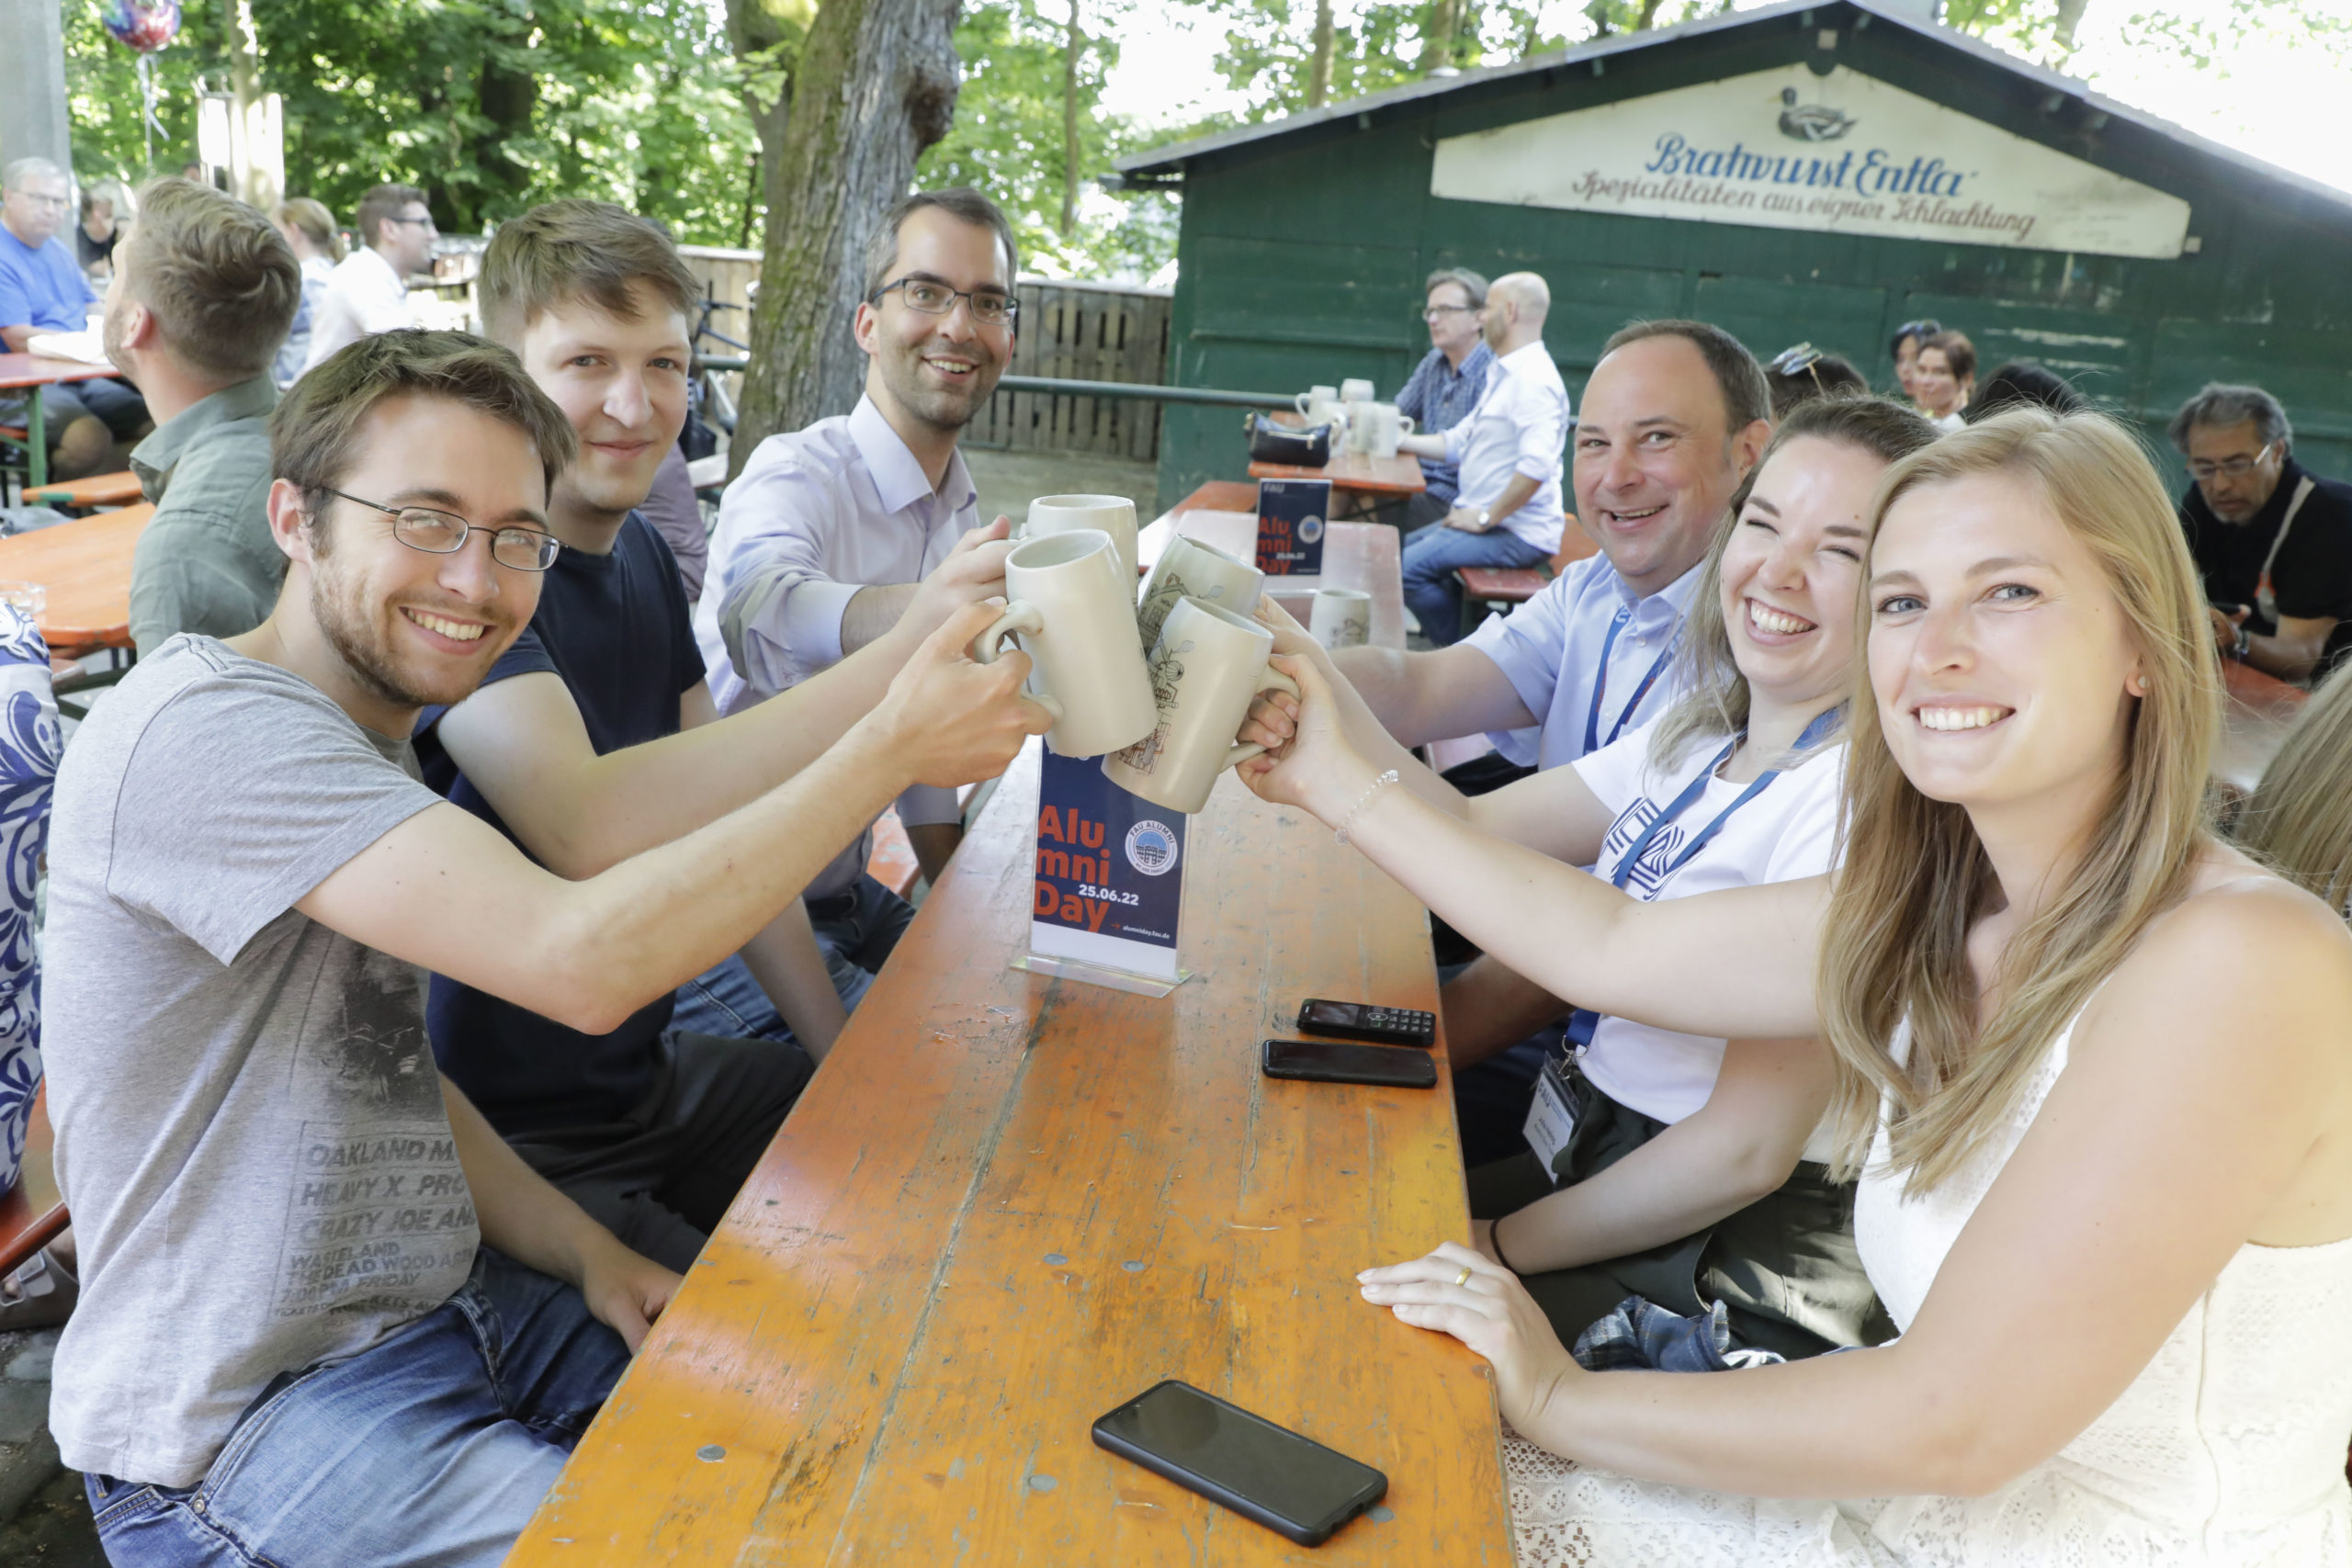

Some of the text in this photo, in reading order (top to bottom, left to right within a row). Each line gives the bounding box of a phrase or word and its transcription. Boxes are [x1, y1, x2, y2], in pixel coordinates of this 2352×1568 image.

[1645, 131, 1854, 188] Bratwurst
[1572, 169, 1755, 209] Spezialitäten
[1762, 190, 1803, 214] aus
[1890, 194, 2037, 243] Schlachtung
[1258, 516, 1291, 536] Alu
[1256, 534, 1293, 554] mni
[1255, 555, 1292, 577] Day
[1037, 805, 1105, 849] Alu
[1130, 821, 1174, 844] FAU ALUMNI
[1035, 848, 1111, 886] mni
[1034, 880, 1111, 933] Day
[1079, 884, 1139, 907] 25.06.22
[308, 1139, 426, 1168] OAKLAND
[301, 1177, 379, 1205] HEAVY
[383, 1175, 405, 1198] X
[301, 1212, 382, 1239] CRAZY
[390, 1209, 434, 1231] JOE
[292, 1242, 401, 1268] WASTELAND
[382, 1255, 435, 1270] WOOD
[356, 1272, 421, 1290] FRIDAY
